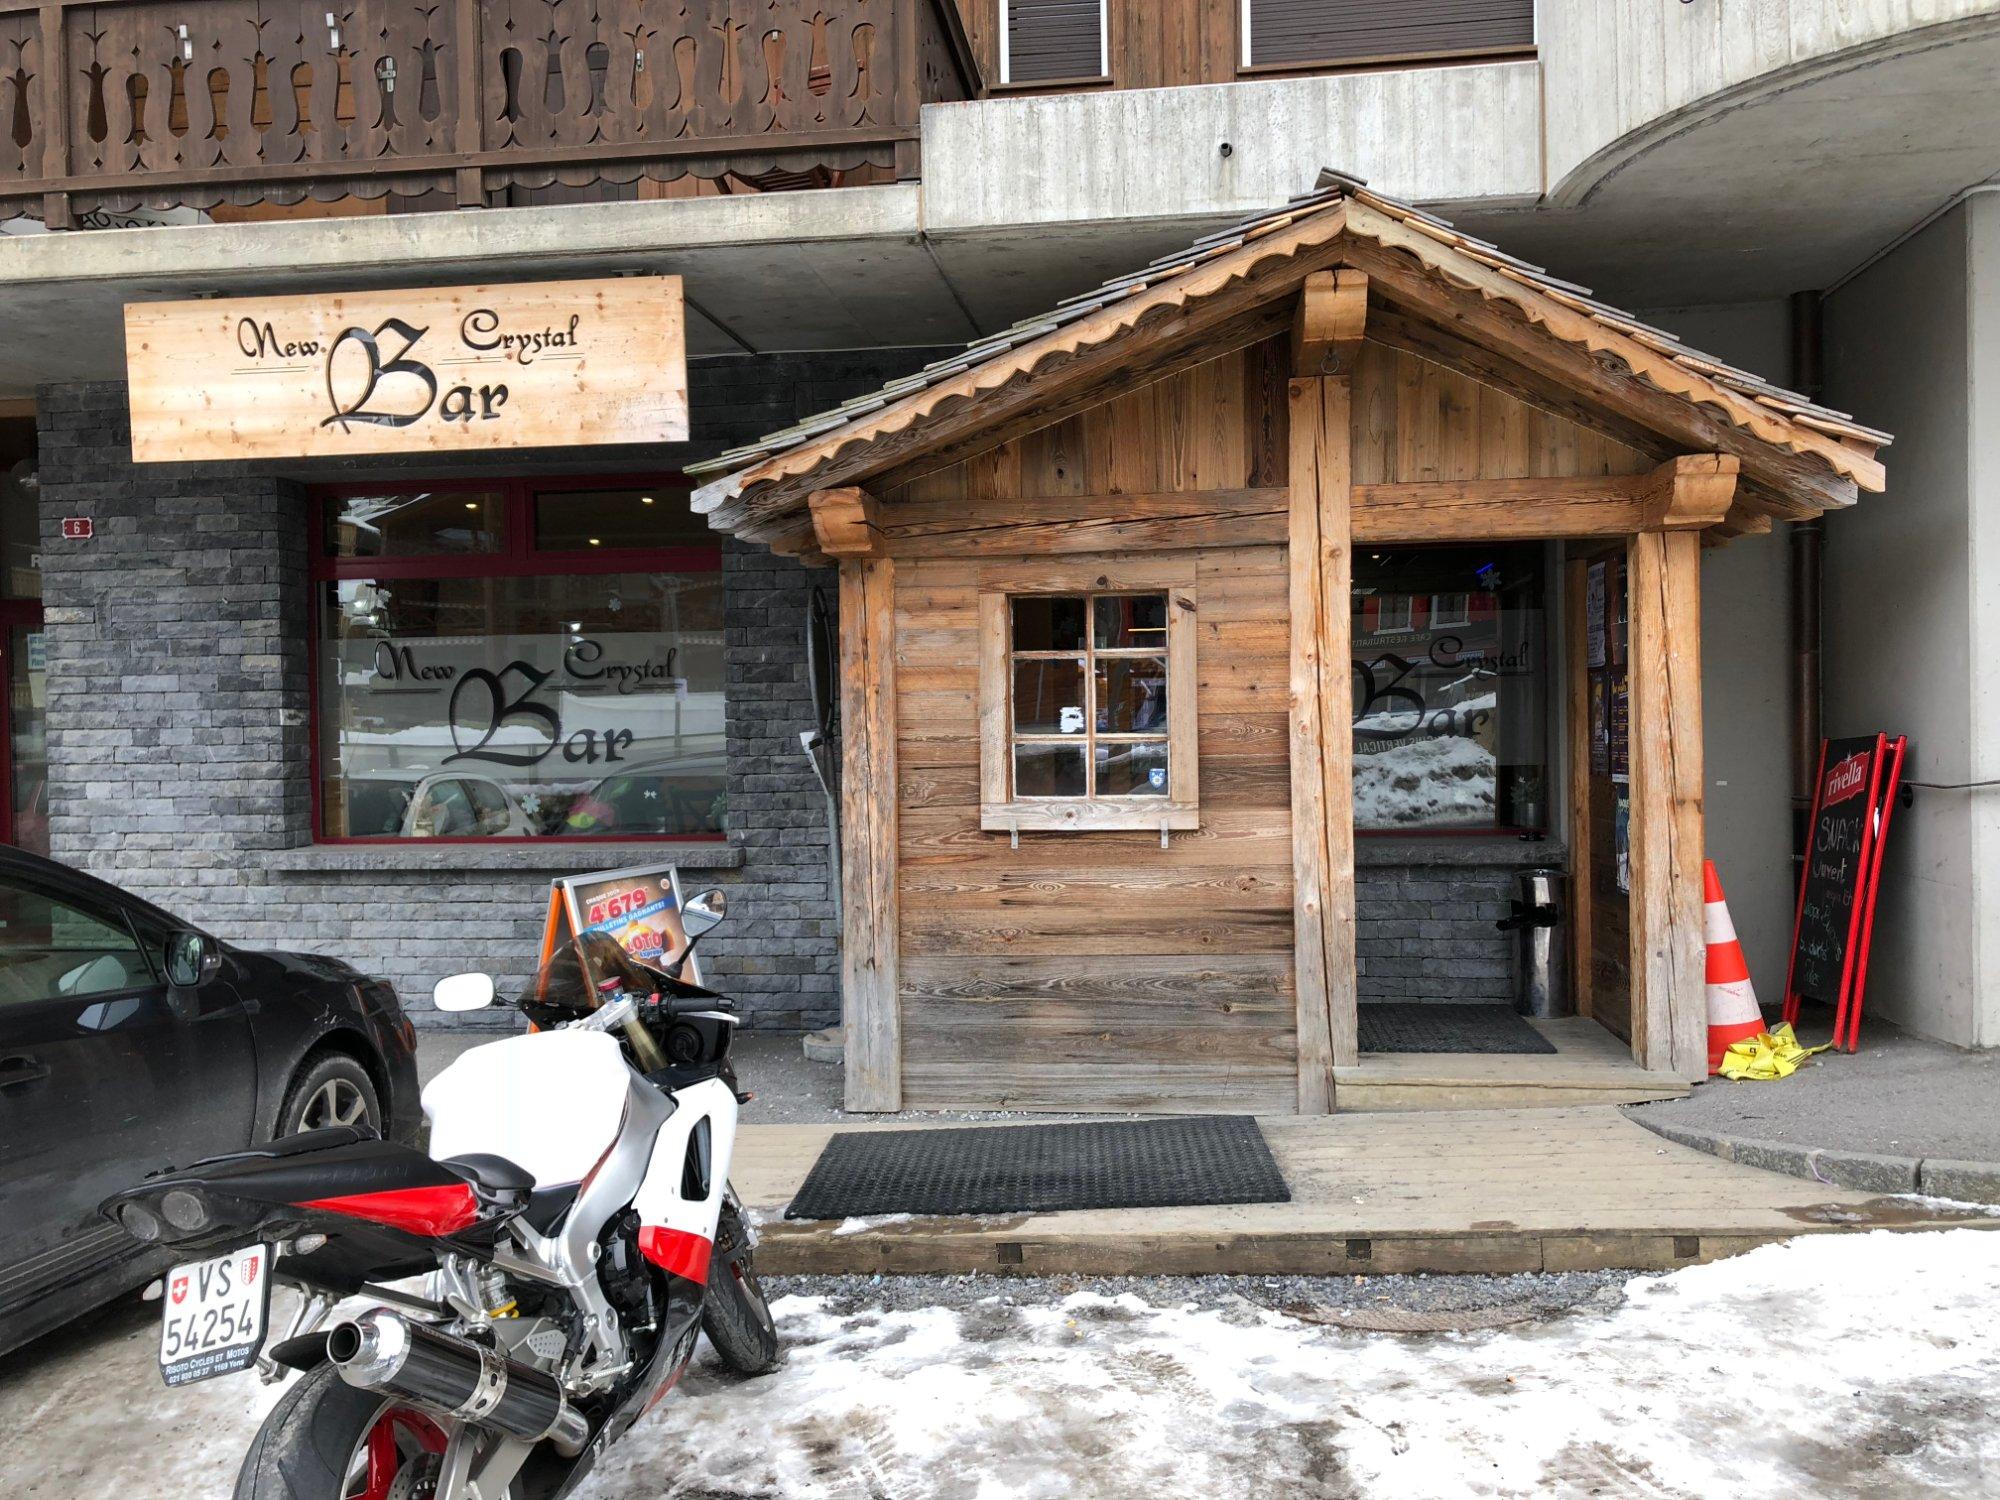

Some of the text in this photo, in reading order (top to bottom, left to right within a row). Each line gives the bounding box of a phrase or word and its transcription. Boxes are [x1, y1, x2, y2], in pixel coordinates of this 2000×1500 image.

[237, 308, 579, 365] New Crystal
[320, 317, 509, 433] Bar
[74, 522, 80, 534] 6
[374, 640, 677, 695] New Crystal
[1429, 636, 1529, 681] Crystal
[441, 660, 634, 767] Bar
[1351, 653, 1489, 738] Bar
[1828, 764, 1863, 797] rivella
[625, 932, 663, 954] LOTO
[199, 1259, 232, 1302] VS
[166, 1299, 253, 1357] 54254
